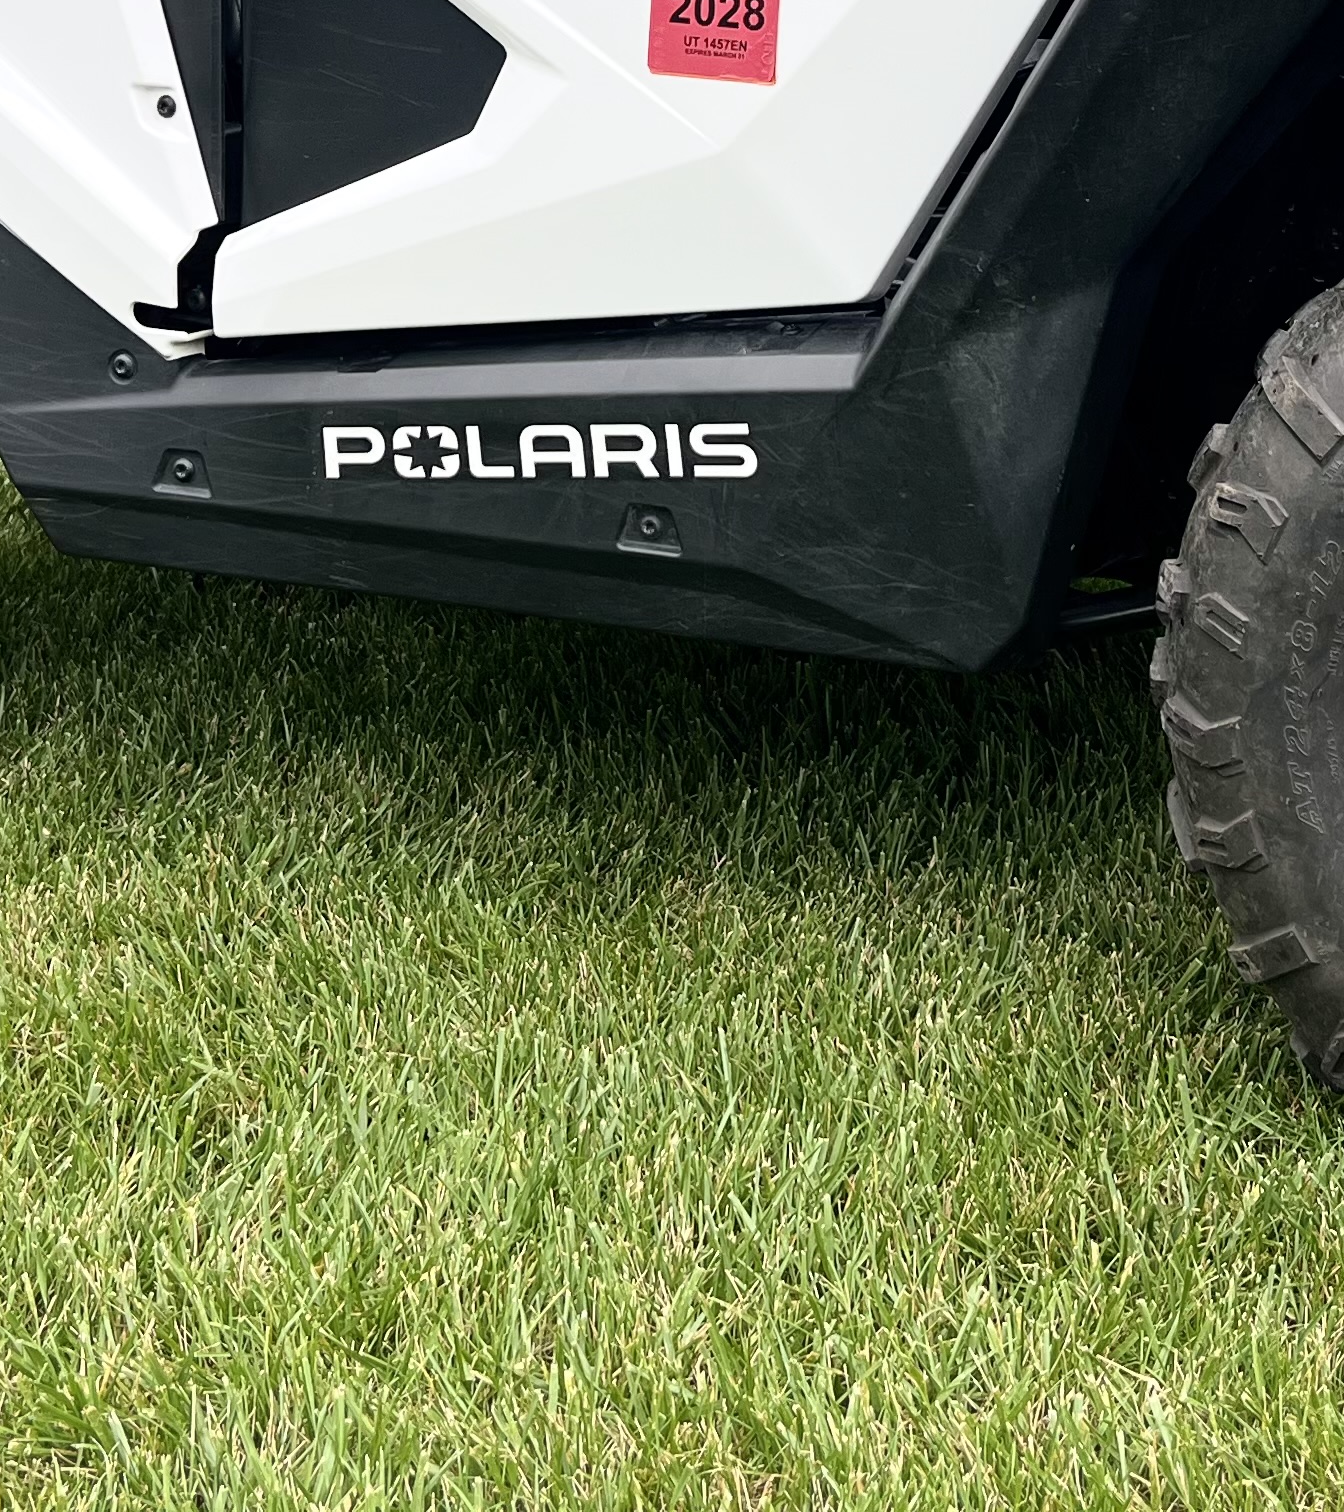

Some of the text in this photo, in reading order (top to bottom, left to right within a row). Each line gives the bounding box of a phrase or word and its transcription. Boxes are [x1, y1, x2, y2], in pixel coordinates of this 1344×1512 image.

[684, 35, 747, 52] UT 1457EN
[322, 422, 758, 479] POLARIS
